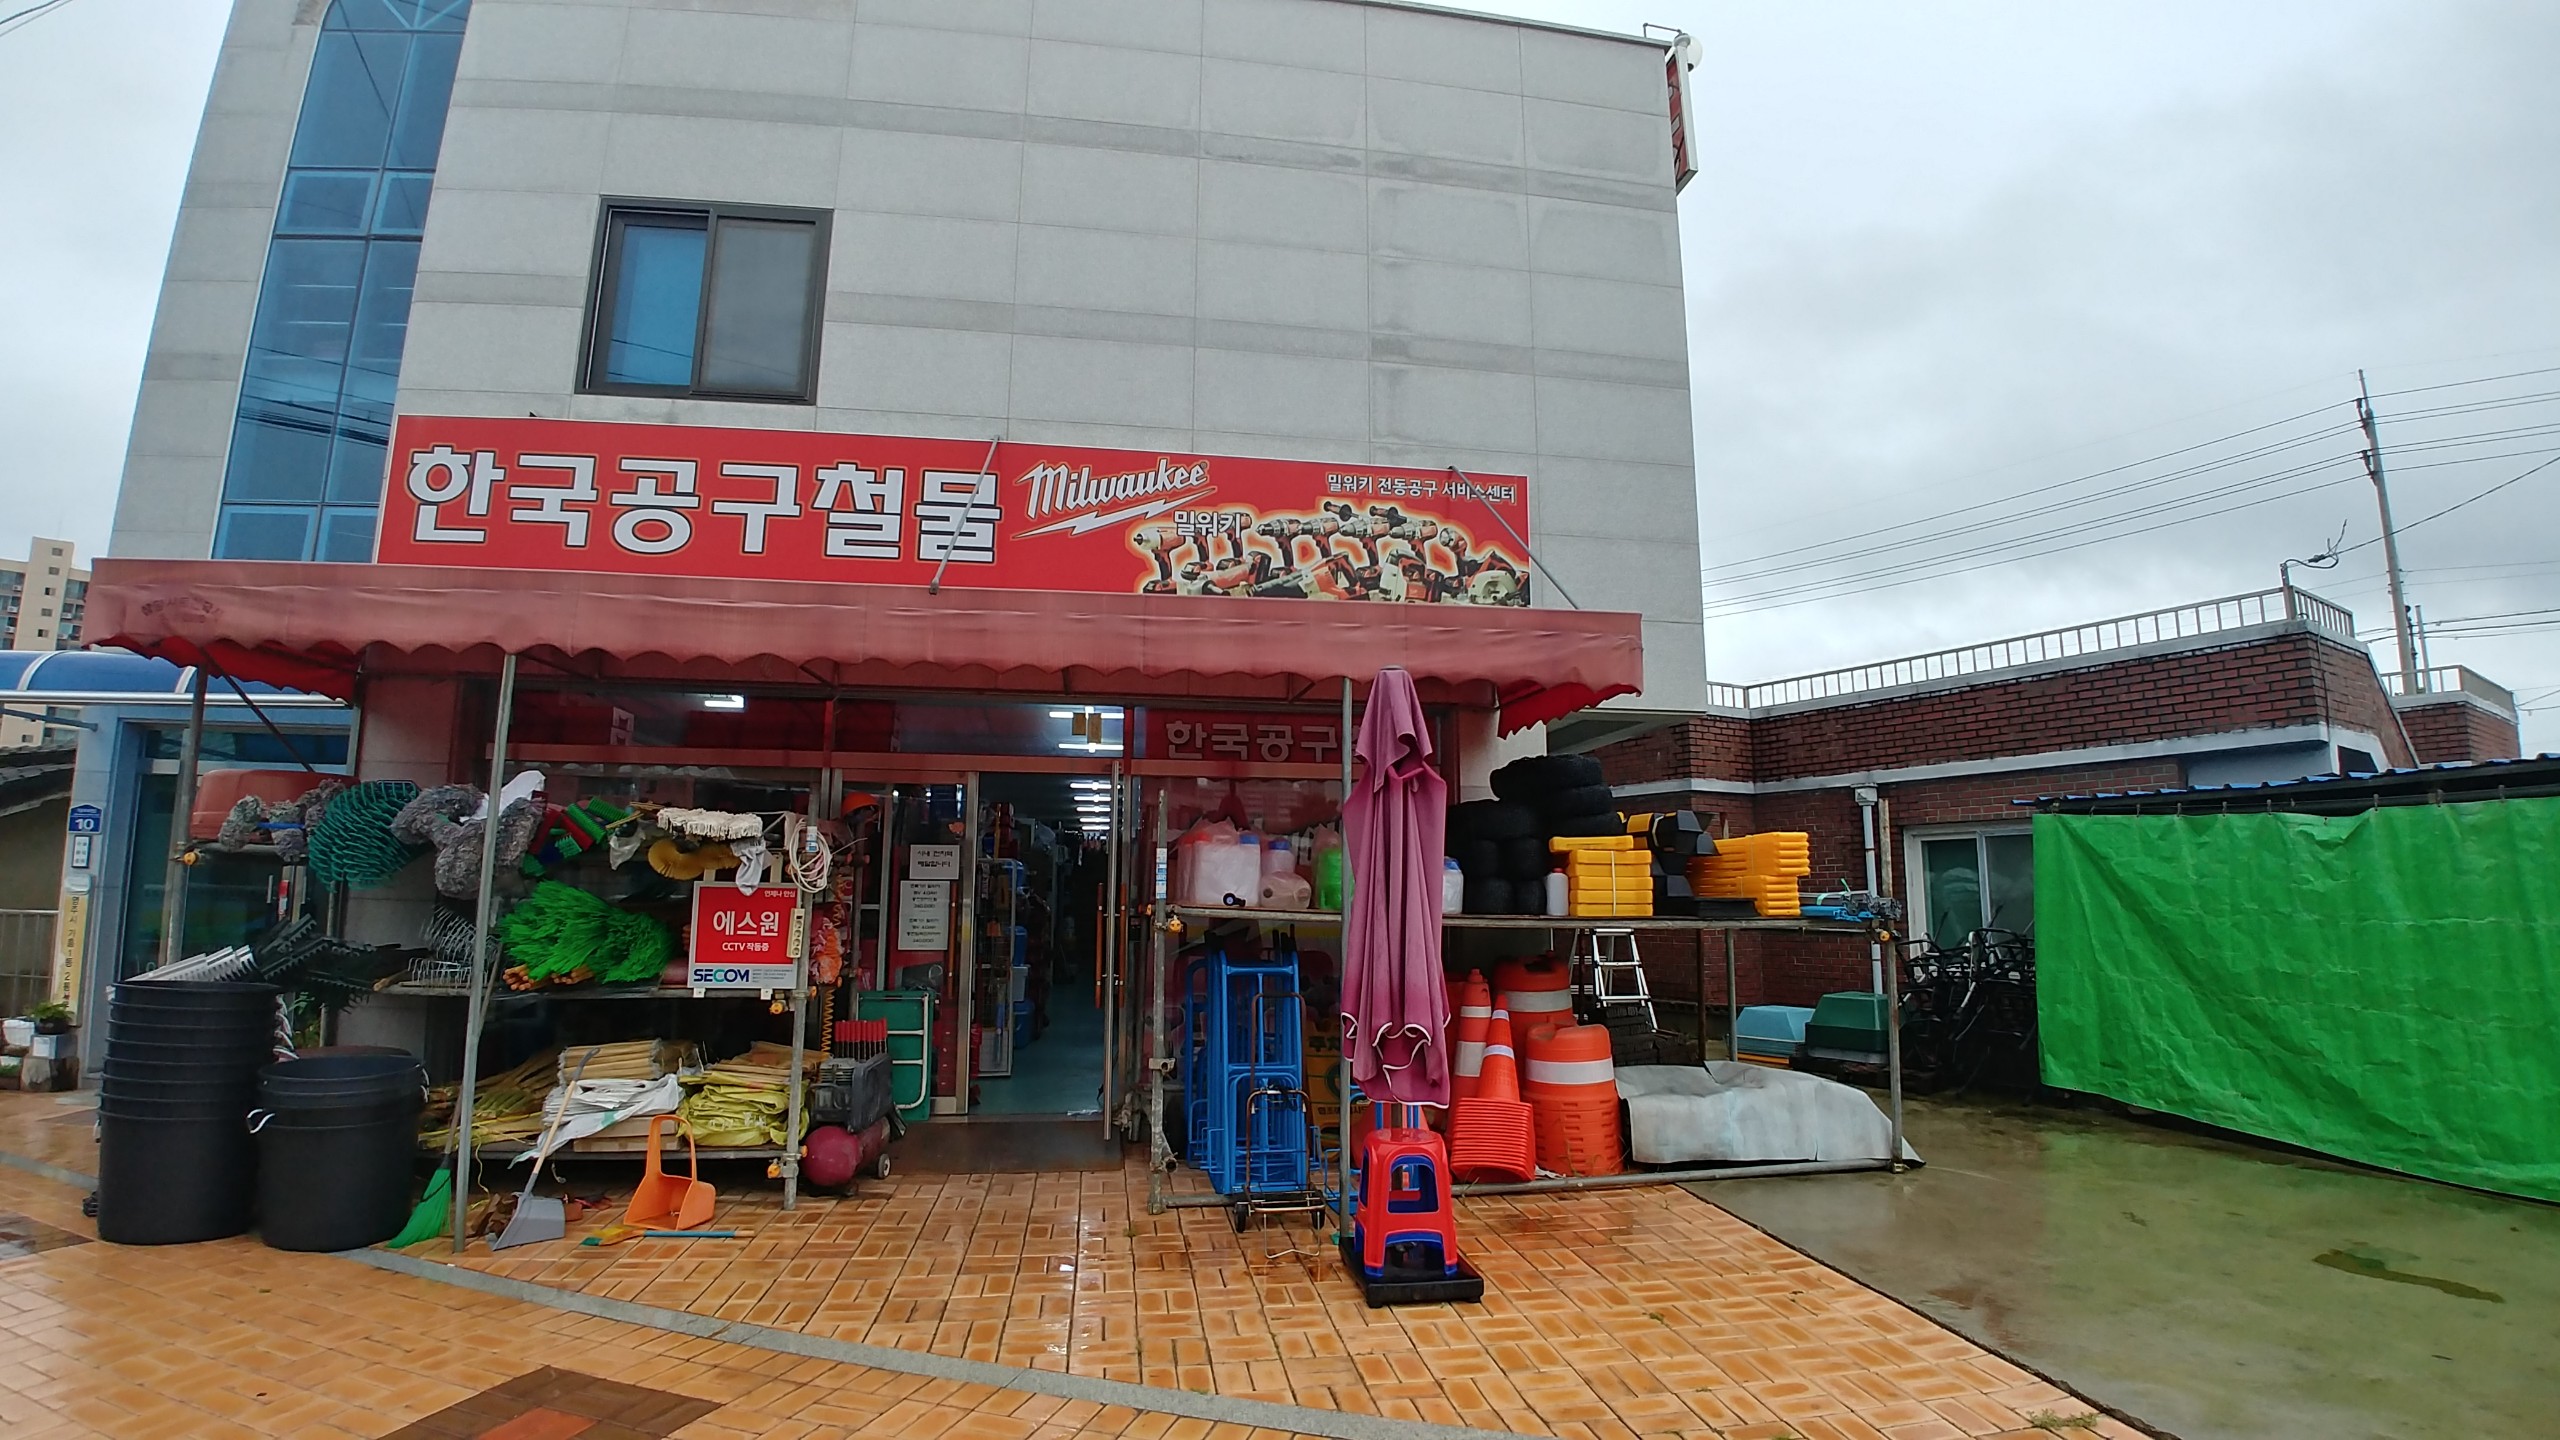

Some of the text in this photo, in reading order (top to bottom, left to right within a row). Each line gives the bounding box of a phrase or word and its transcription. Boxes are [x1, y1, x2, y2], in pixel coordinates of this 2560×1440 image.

[1015, 458, 1207, 519] Milwaukee
[1327, 474, 1516, 503] 밀워키 전동공구 서비스센터
[406, 444, 1001, 563] 한국공구철물
[1174, 510, 1242, 539] 밀워키
[1165, 720, 1363, 763] 한국공구
[75, 818, 94, 830] 10
[713, 910, 780, 937] 에스원
[722, 942, 770, 952] CCTV 작동중
[693, 968, 750, 983] SECOM
